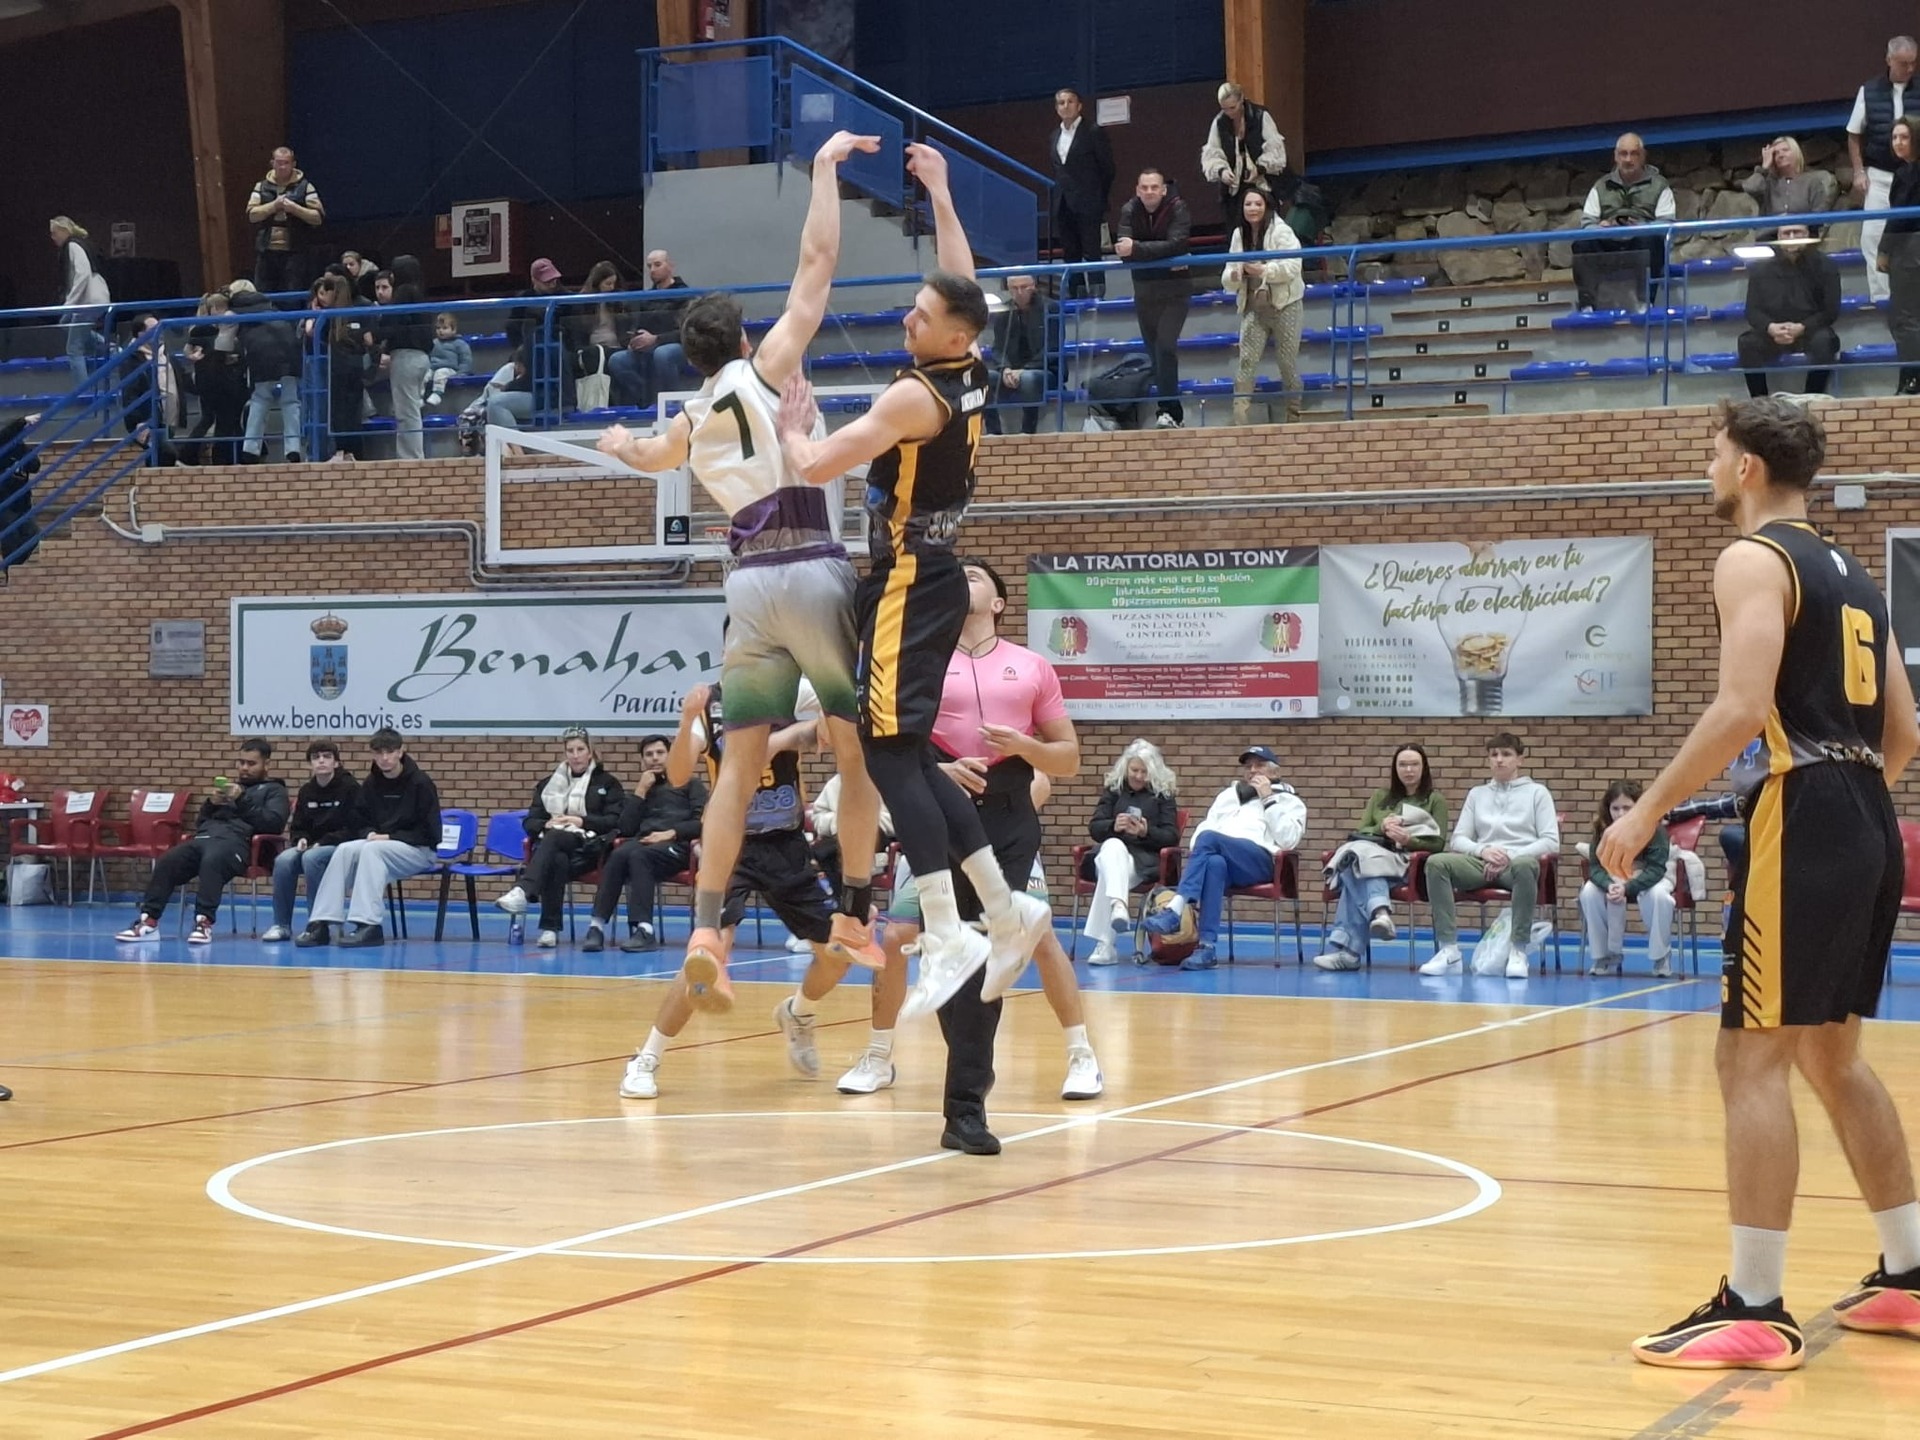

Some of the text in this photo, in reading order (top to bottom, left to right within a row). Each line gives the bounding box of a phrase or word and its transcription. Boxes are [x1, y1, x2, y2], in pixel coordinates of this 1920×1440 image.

[1053, 550, 1289, 571] LA TRATTORIA DI TONY
[1364, 542, 1584, 592] ¿Quieres ahorrar en tu
[1383, 575, 1611, 627] factura de electricidad?
[1841, 603, 1877, 706] 6
[238, 706, 422, 730] www.benahavis.es
